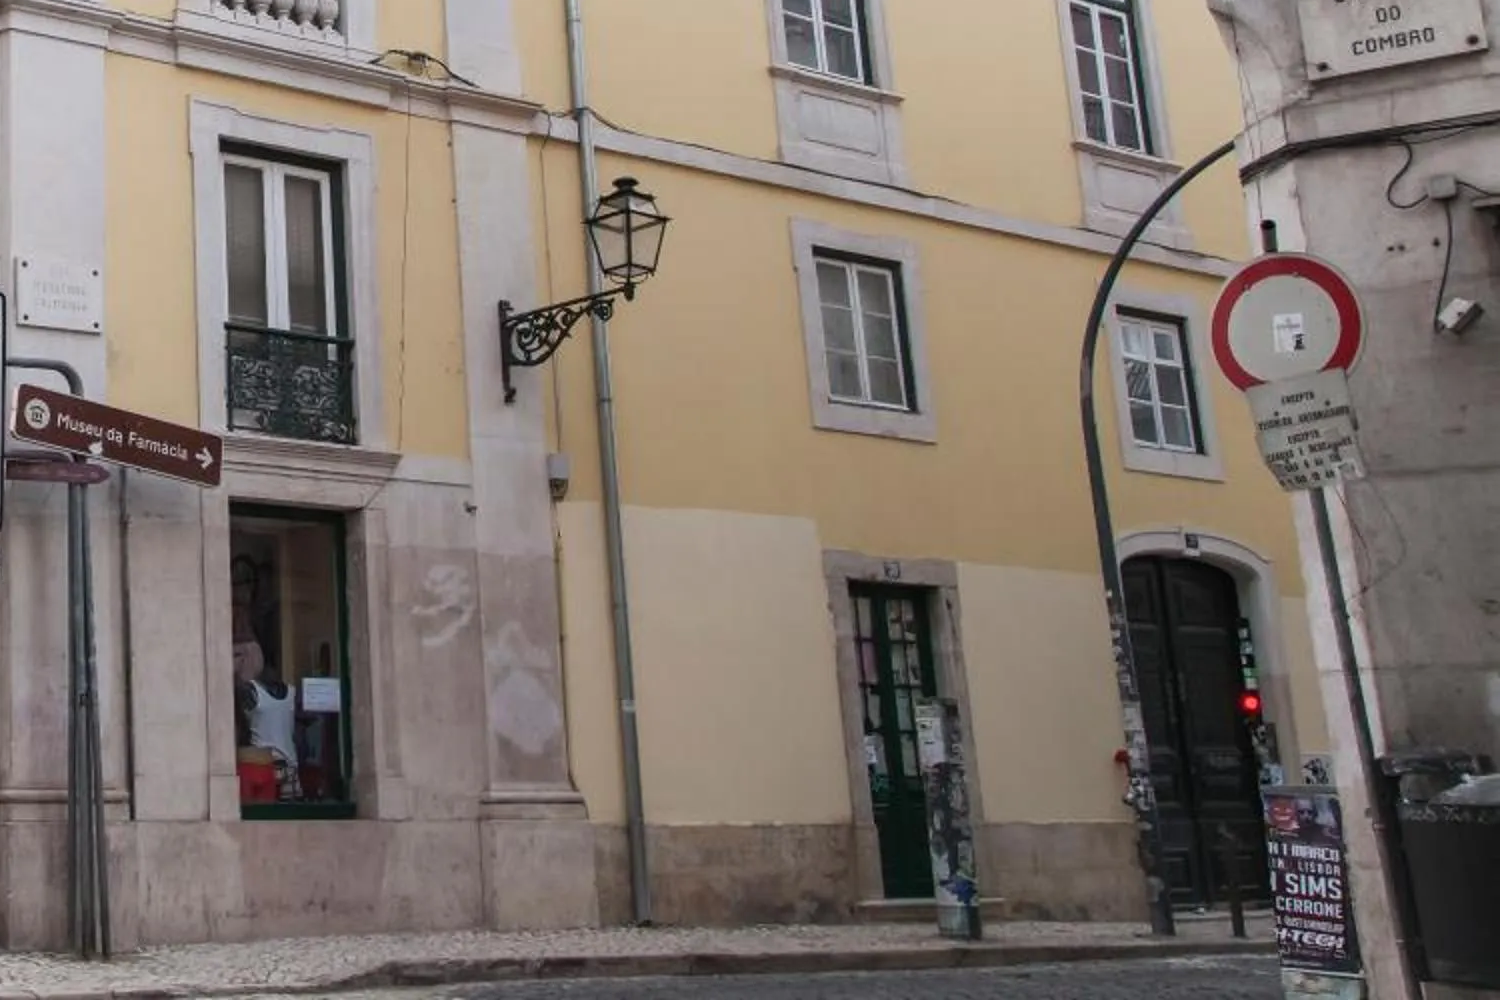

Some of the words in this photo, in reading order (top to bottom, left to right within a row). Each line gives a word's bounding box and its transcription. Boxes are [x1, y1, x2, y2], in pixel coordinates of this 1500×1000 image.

[1375, 4, 1402, 23] DO
[1351, 26, 1436, 57] COMBRO
[56, 411, 103, 438] Museu
[106, 427, 123, 443] da
[1285, 872, 1342, 899] SIMS
